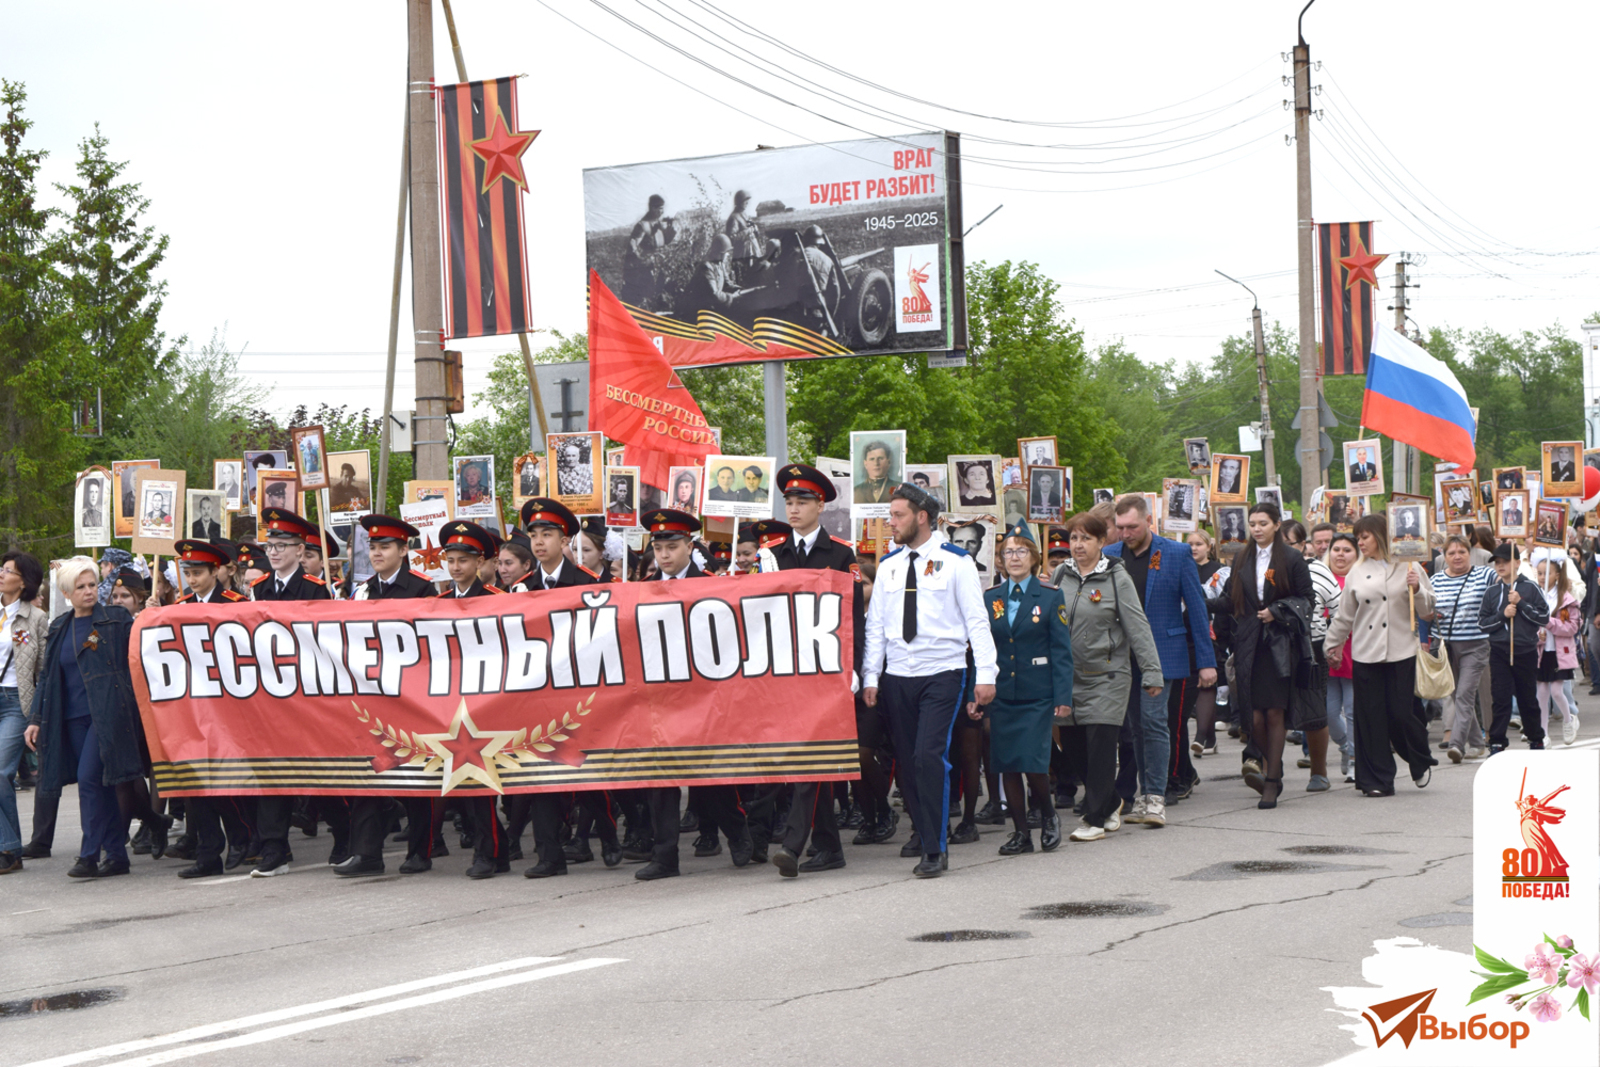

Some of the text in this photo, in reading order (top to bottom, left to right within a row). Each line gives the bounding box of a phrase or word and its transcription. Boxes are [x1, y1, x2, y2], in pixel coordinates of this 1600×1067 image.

[893, 147, 936, 171] ВРАГ
[809, 173, 936, 206] БУДЕТ РАЗБИТ!
[902, 296, 919, 313] 80
[902, 313, 934, 324] ПОБЕДА!
[606, 384, 710, 429] БЕССМЕРТНЫ
[403, 511, 447, 523] Бессмертный
[140, 590, 844, 702] БЕССМЕРТНЫЙ ПОЛК
